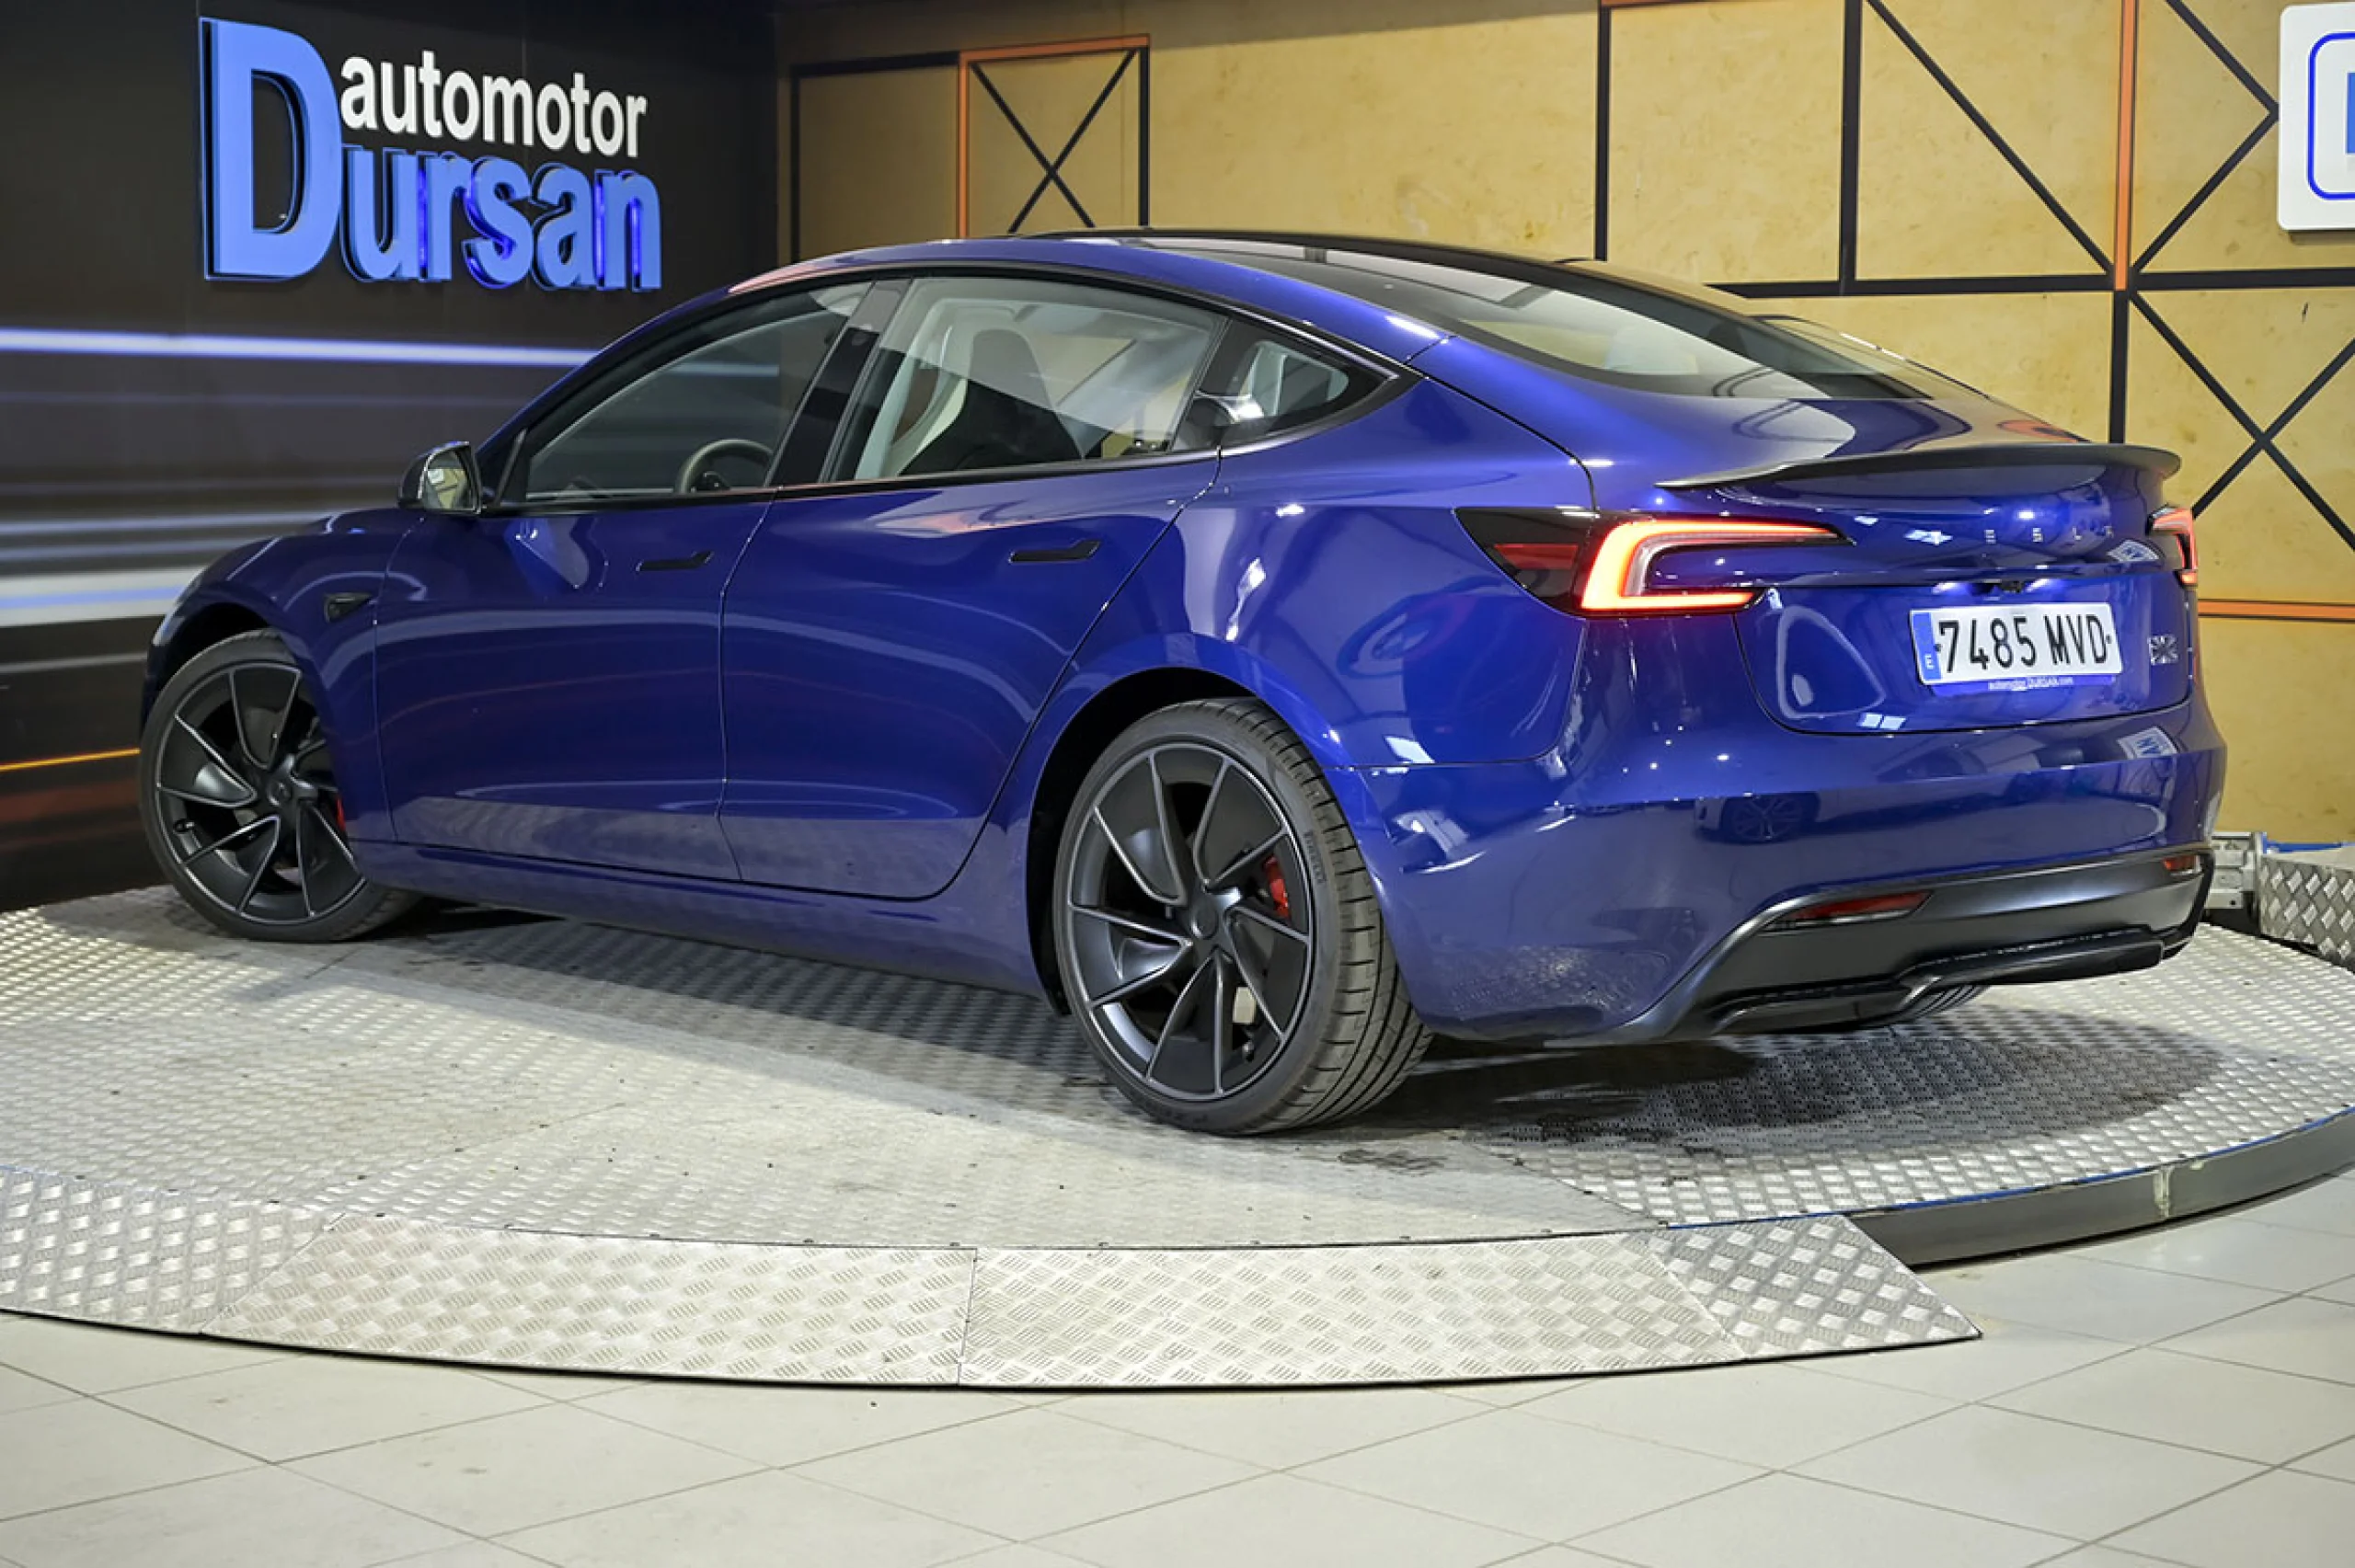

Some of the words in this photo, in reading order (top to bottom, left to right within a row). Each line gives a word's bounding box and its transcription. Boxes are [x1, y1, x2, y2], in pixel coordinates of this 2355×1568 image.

[199, 16, 661, 292] Dursan
[339, 51, 647, 157] automotor
[1938, 615, 2037, 673] 7485
[2043, 613, 2108, 665] MVD
